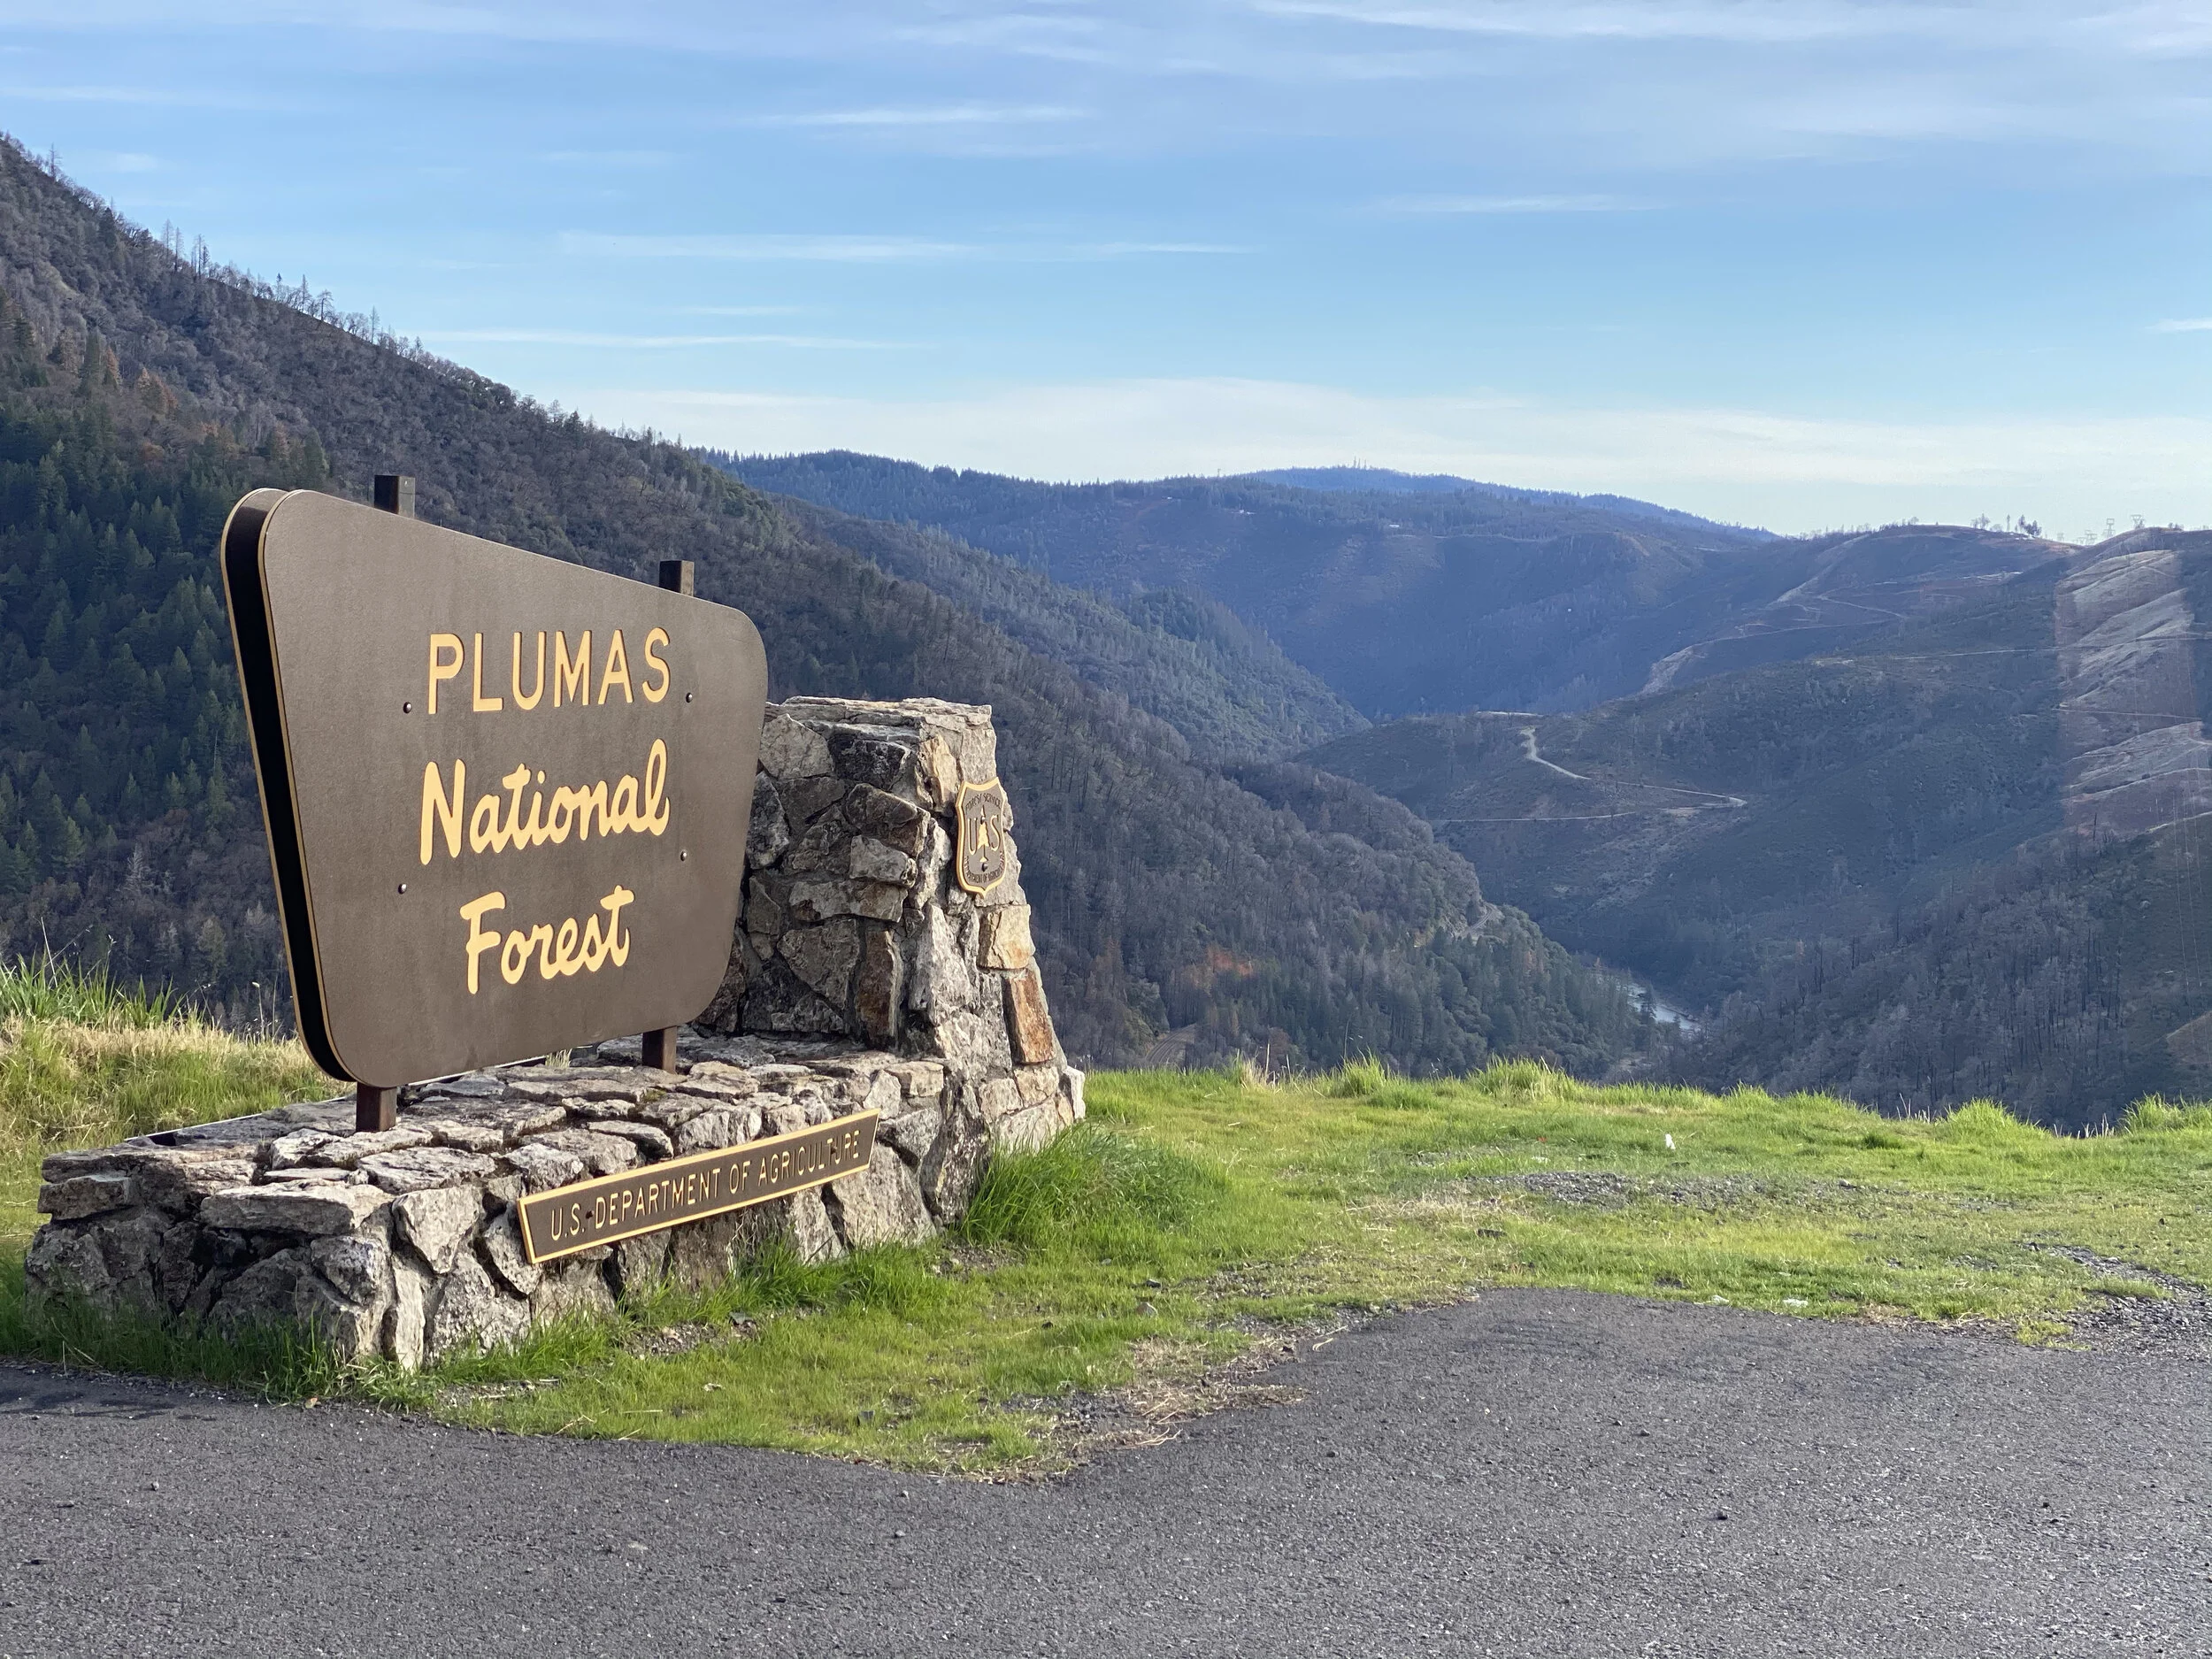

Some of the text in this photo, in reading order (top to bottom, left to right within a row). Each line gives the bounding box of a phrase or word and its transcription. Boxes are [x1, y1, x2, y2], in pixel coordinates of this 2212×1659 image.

[428, 626, 671, 715] PLUMAS
[419, 738, 670, 865] National
[459, 886, 634, 995] Forest
[550, 1130, 861, 1241] U.S. DEPARTMENT OF AGRICULTURE
